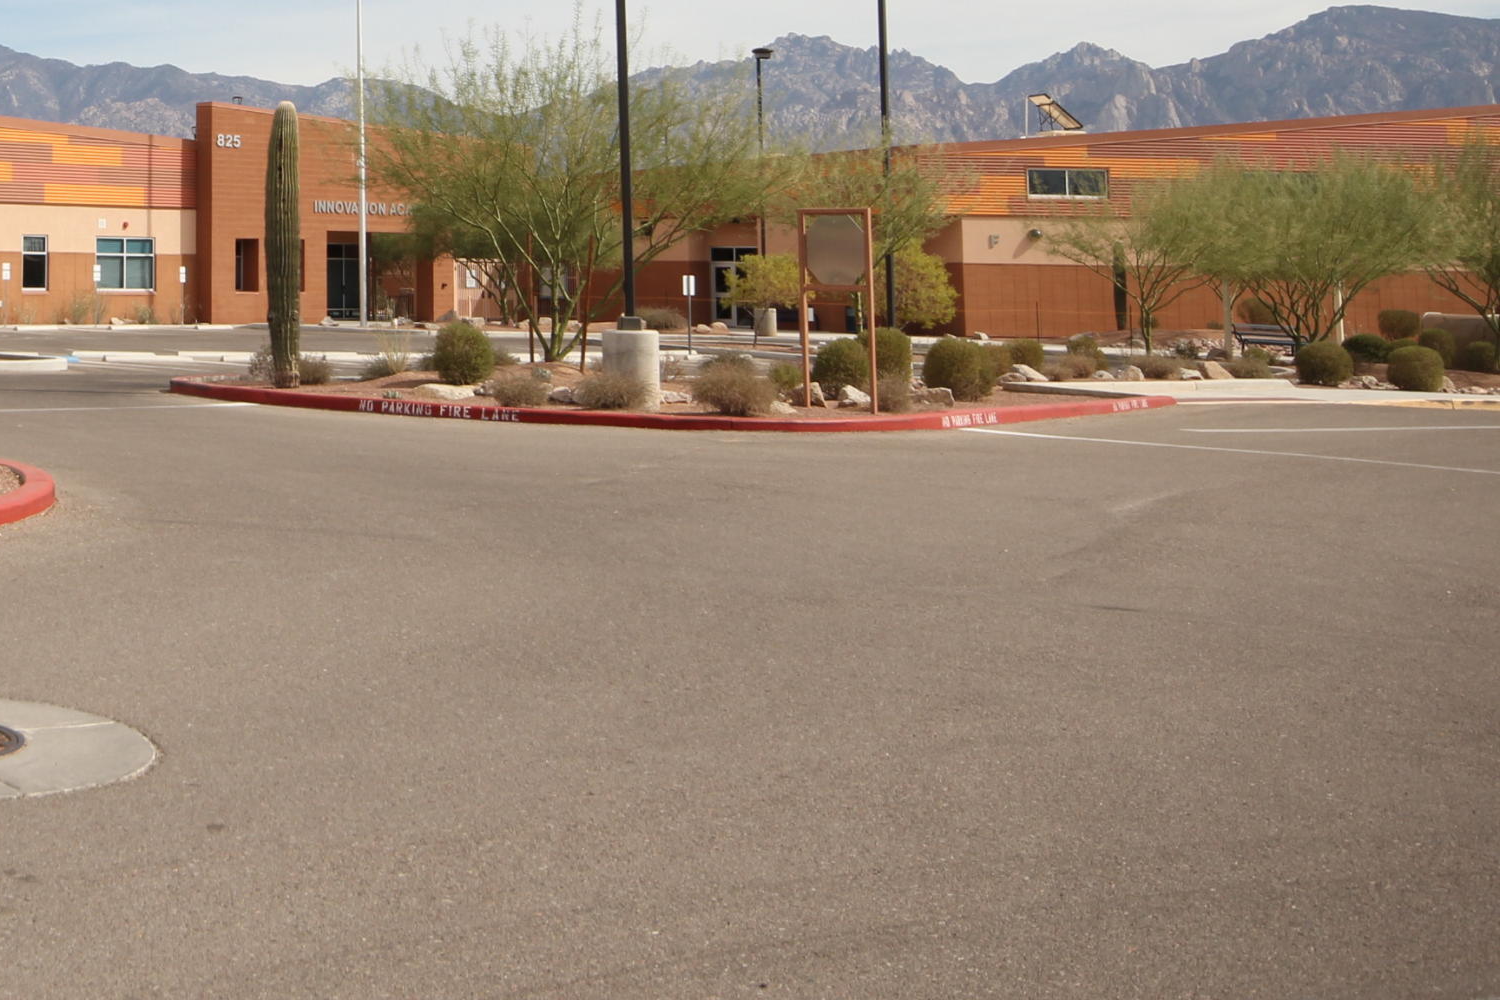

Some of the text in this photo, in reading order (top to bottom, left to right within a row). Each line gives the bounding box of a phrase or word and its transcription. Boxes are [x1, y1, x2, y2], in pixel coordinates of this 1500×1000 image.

[216, 133, 242, 148] 825
[313, 199, 387, 216] INNOVAION
[358, 399, 520, 422] NO PARKING FIRE LANE
